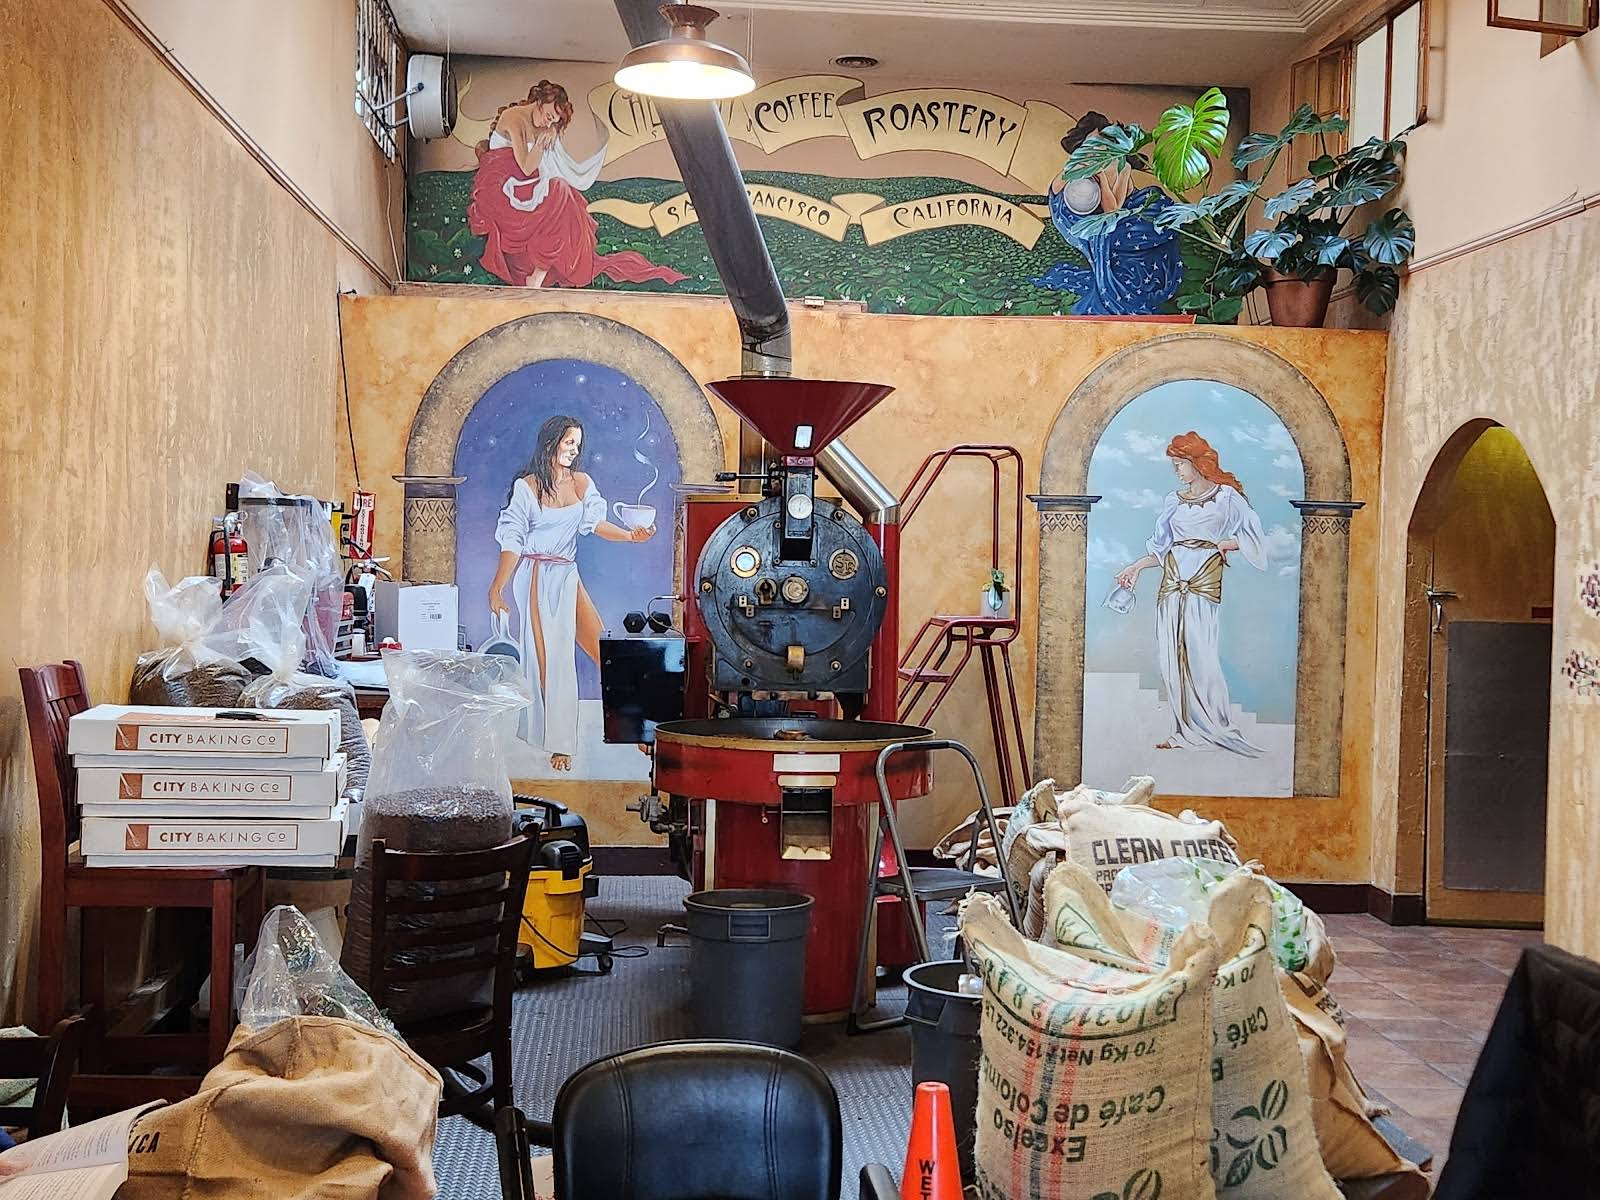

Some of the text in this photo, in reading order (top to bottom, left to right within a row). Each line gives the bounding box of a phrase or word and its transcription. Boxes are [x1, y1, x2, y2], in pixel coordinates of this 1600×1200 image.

[755, 92, 835, 133] COFFEE
[863, 101, 1018, 146] ROASTERY
[667, 190, 831, 226] SA ANCISCO
[893, 198, 1012, 229] CALIFORNIA
[356, 498, 373, 508] FRE
[149, 733, 183, 744] CITY
[186, 734, 252, 746] BAKING
[153, 781, 187, 792] CITY
[190, 782, 256, 793] BAKING
[159, 832, 193, 843] CITY
[196, 832, 262, 843] BAKING
[1092, 838, 1165, 866] CLEAN
[1100, 1042, 1130, 1063] Kg
[1135, 1037, 1157, 1058] 70
[984, 1056, 1166, 1130] Café de Colom
[993, 1107, 1088, 1163] Excelso
[919, 1159, 936, 1200] WET
